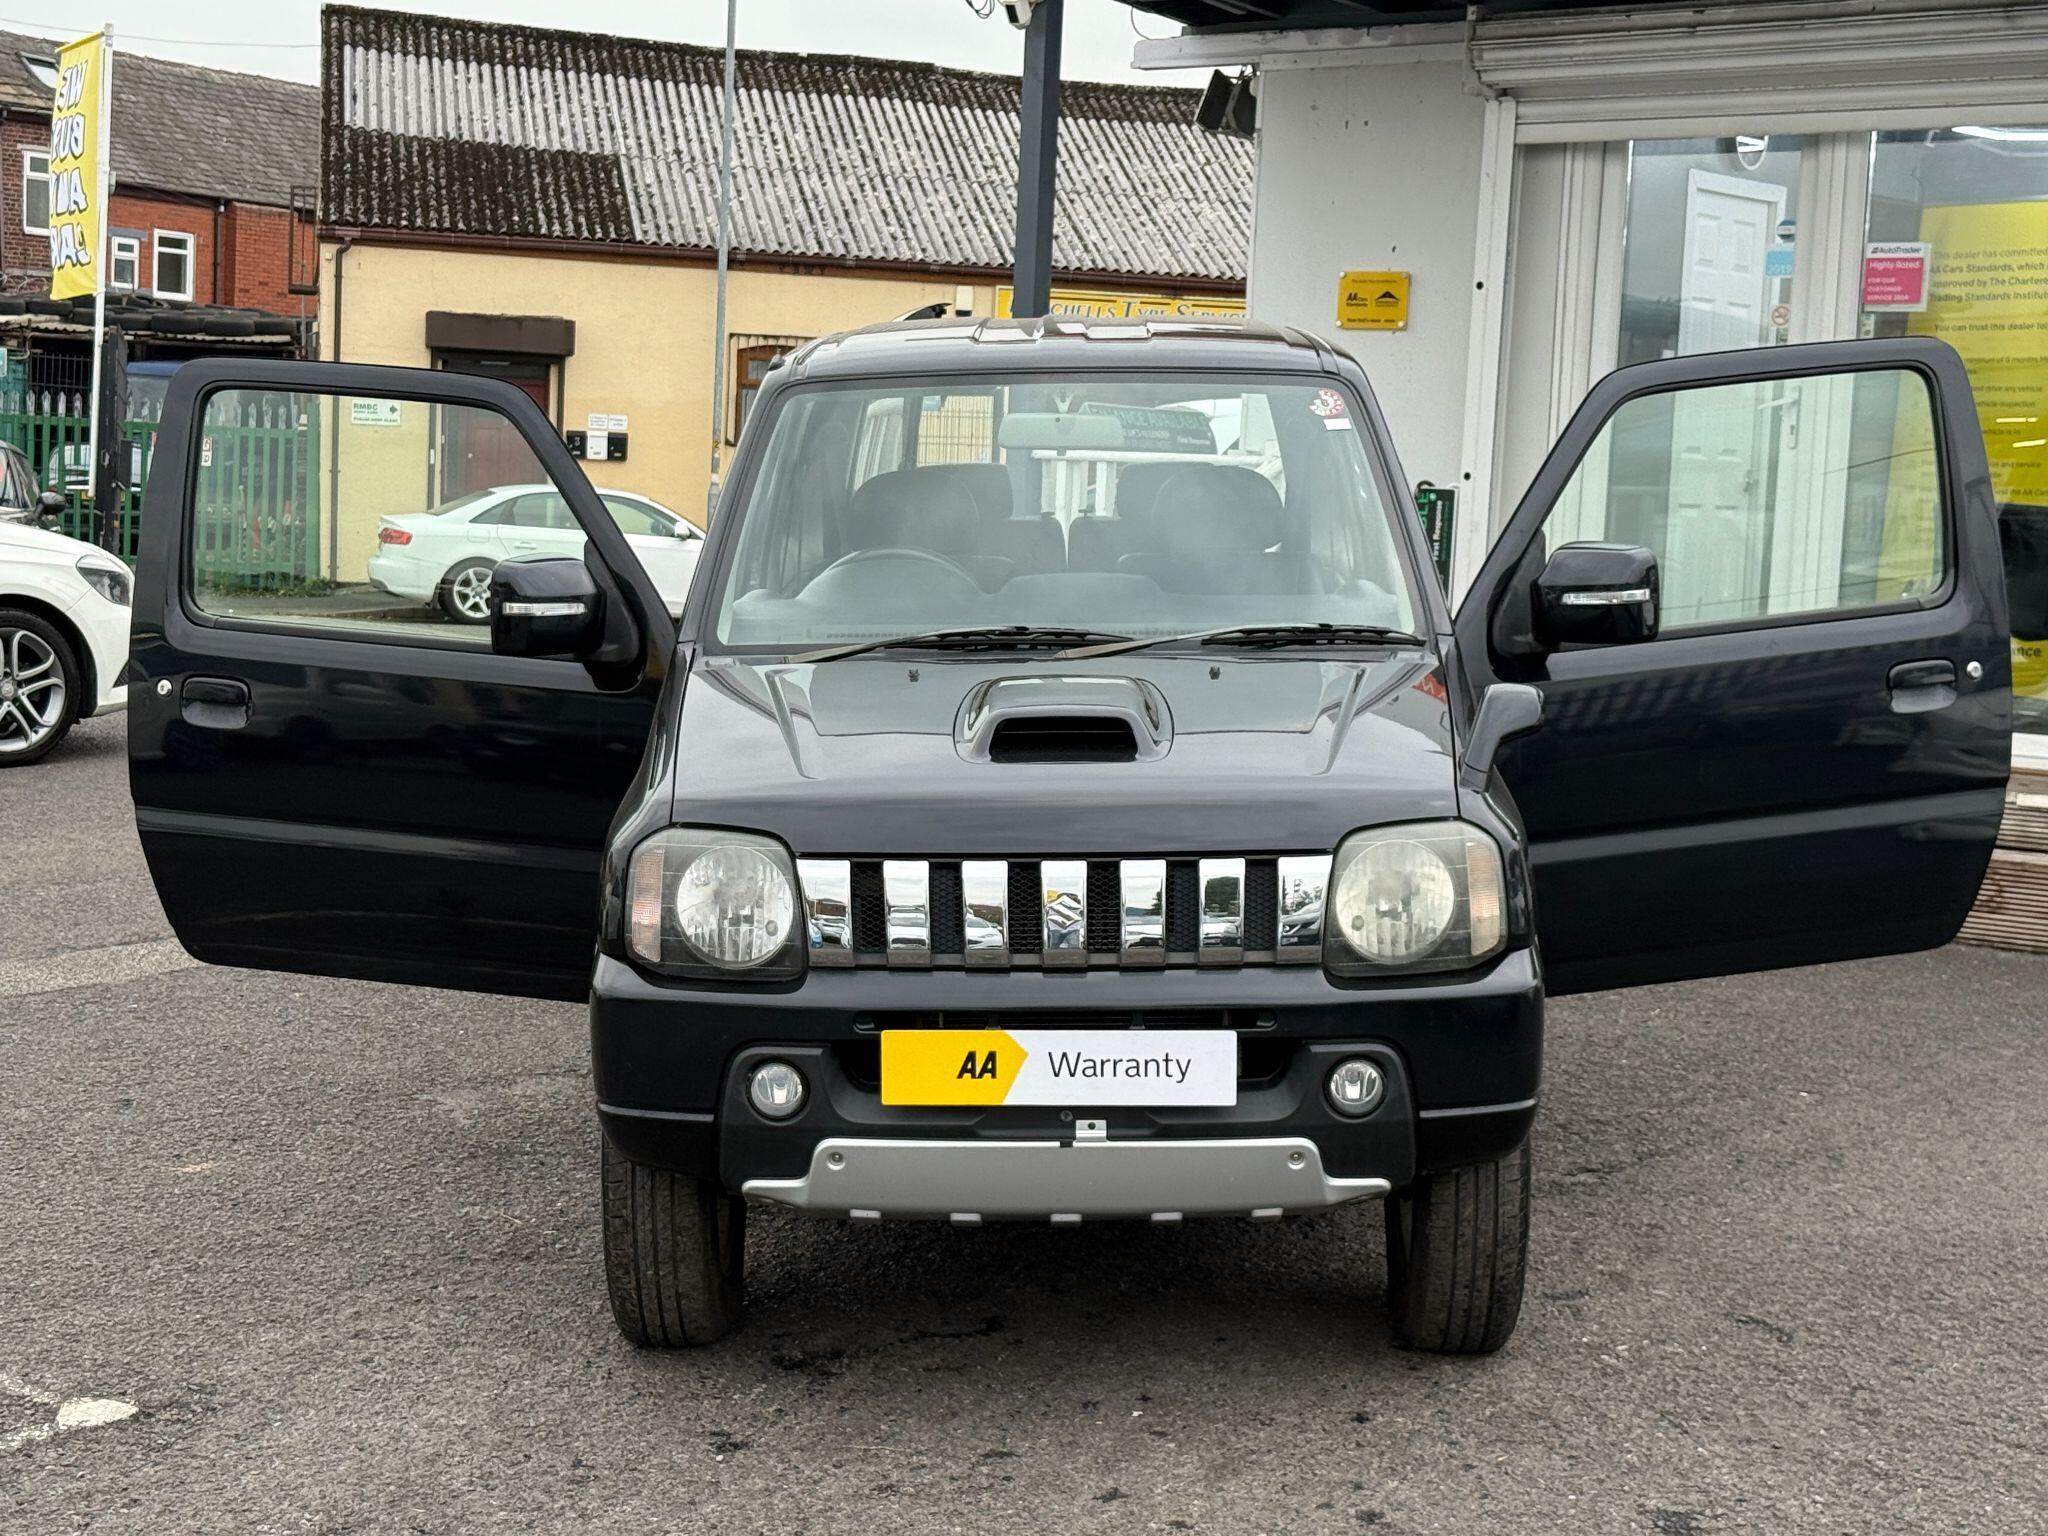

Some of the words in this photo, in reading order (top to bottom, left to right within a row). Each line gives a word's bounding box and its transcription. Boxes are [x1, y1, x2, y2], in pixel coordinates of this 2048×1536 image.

[1952, 250, 1980, 260] dealer
[1983, 249, 1997, 258] has
[1943, 264, 1964, 273] Cars
[2016, 261, 2045, 271] which
[1977, 277, 1987, 288] by
[1989, 277, 2006, 286] The
[2008, 276, 2048, 286] Chartere
[1965, 291, 2011, 301] Standards
[2013, 290, 2048, 300] Institut
[1952, 324, 1967, 332] can
[1969, 323, 1988, 331] trust
[1990, 322, 2005, 331] this
[2007, 321, 2034, 331] dealer
[956, 1050, 998, 1079] AA
[1048, 1051, 1192, 1084] Warranty
